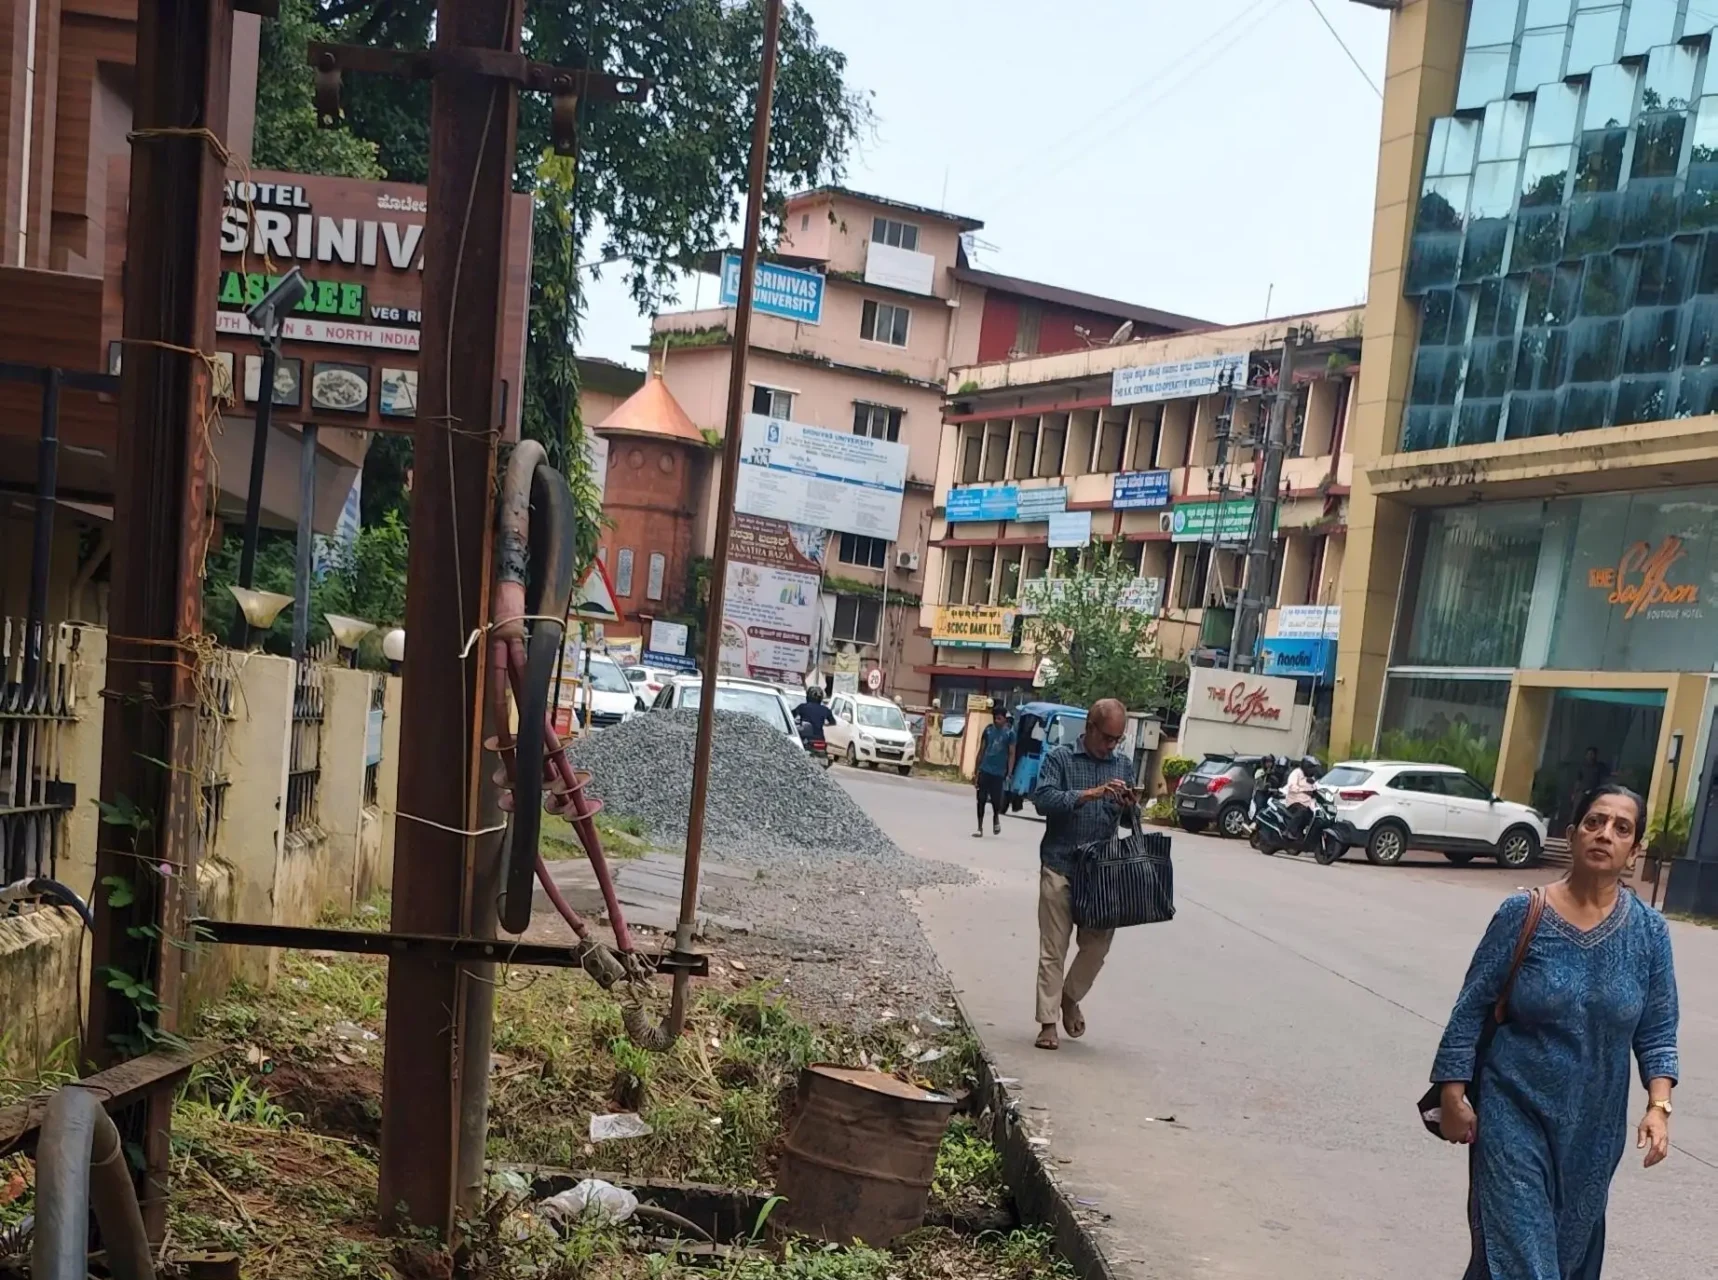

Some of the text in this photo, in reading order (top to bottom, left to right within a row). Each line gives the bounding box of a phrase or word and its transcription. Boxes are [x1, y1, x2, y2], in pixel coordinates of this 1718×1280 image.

[223, 180, 309, 208] HOTEL
[220, 206, 424, 271] SRINIV
[754, 268, 818, 299] SRINIVAS
[752, 286, 816, 314] UNIVERSITY
[371, 306, 399, 321] VEG
[305, 325, 313, 337] &
[326, 327, 373, 342] NORTH
[834, 434, 875, 448] UNIVERSITY
[1681, 608, 1704, 619] HOTEL
[970, 622, 988, 635] BANK
[989, 623, 1002, 636] LTD
[1207, 686, 1226, 701] THE
